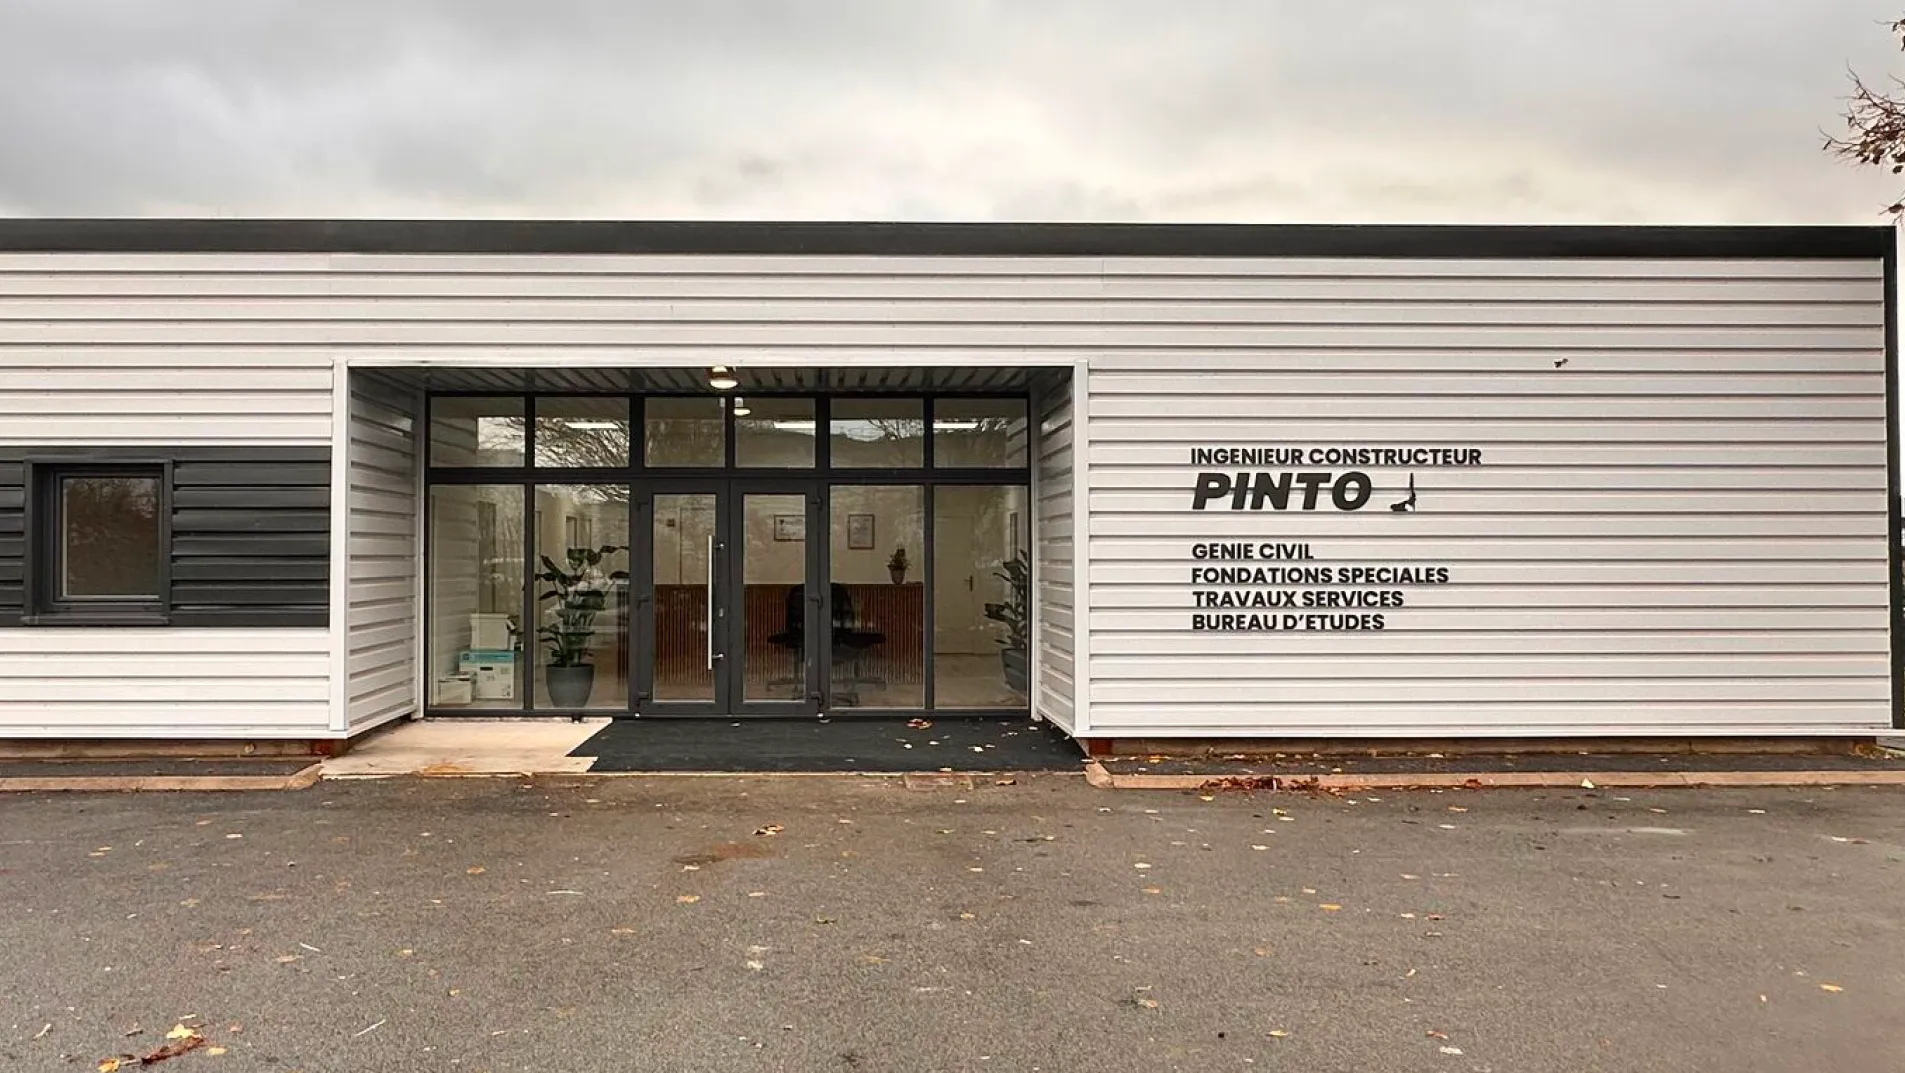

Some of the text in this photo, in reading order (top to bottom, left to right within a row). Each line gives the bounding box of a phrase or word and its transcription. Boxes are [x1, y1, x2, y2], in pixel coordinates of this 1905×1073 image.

[1191, 448, 1483, 466] INGENIEUR CONSTRUCTEUR
[1191, 471, 1373, 511] PINTO
[1192, 543, 1315, 560] GENIE CIVIL
[1192, 567, 1450, 585] FONDATIONS SPECIALES
[1192, 590, 1405, 608] TRAVAUX SERVICES
[1192, 614, 1386, 631] BUREAU D’ETUDES
